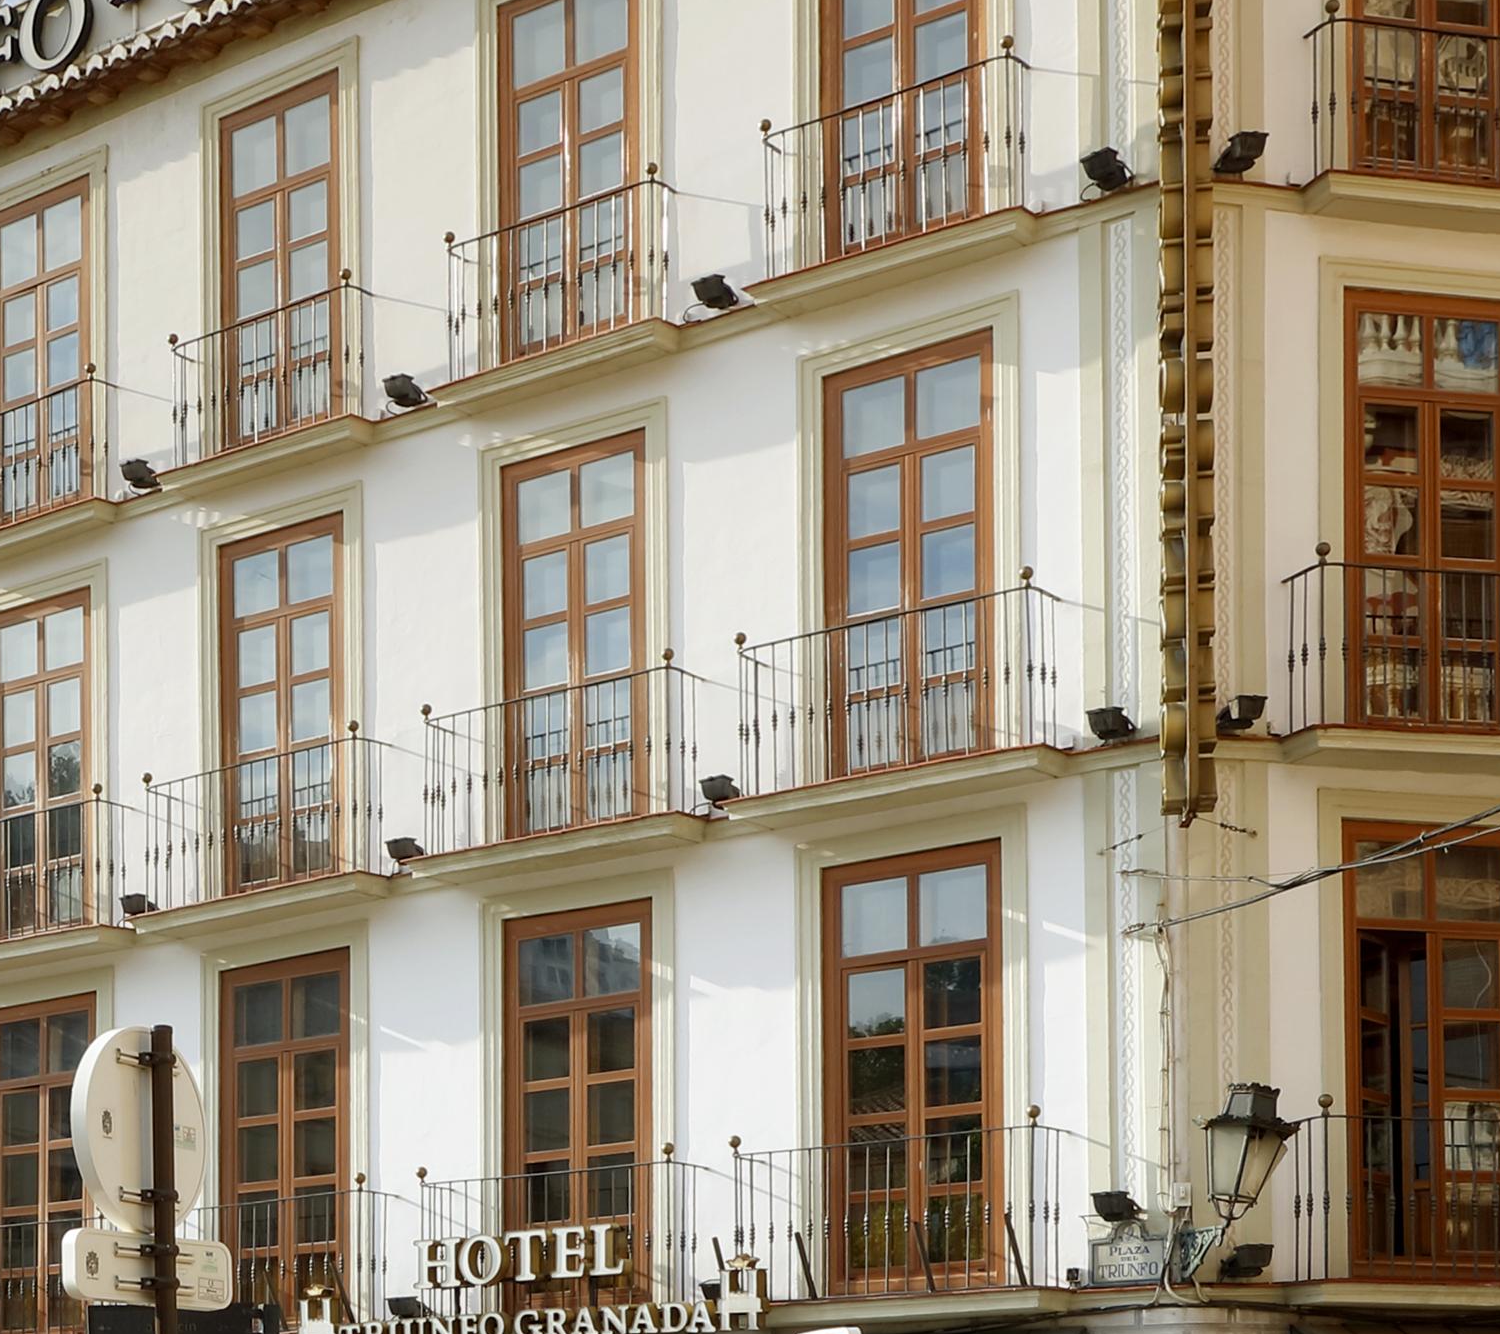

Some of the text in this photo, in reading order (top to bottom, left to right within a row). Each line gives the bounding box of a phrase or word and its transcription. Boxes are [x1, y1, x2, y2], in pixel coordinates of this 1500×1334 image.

[413, 1223, 630, 1291] HOTEL
[1109, 1245, 1150, 1257] PLAZA
[1099, 1261, 1159, 1280] TRIUNFO
